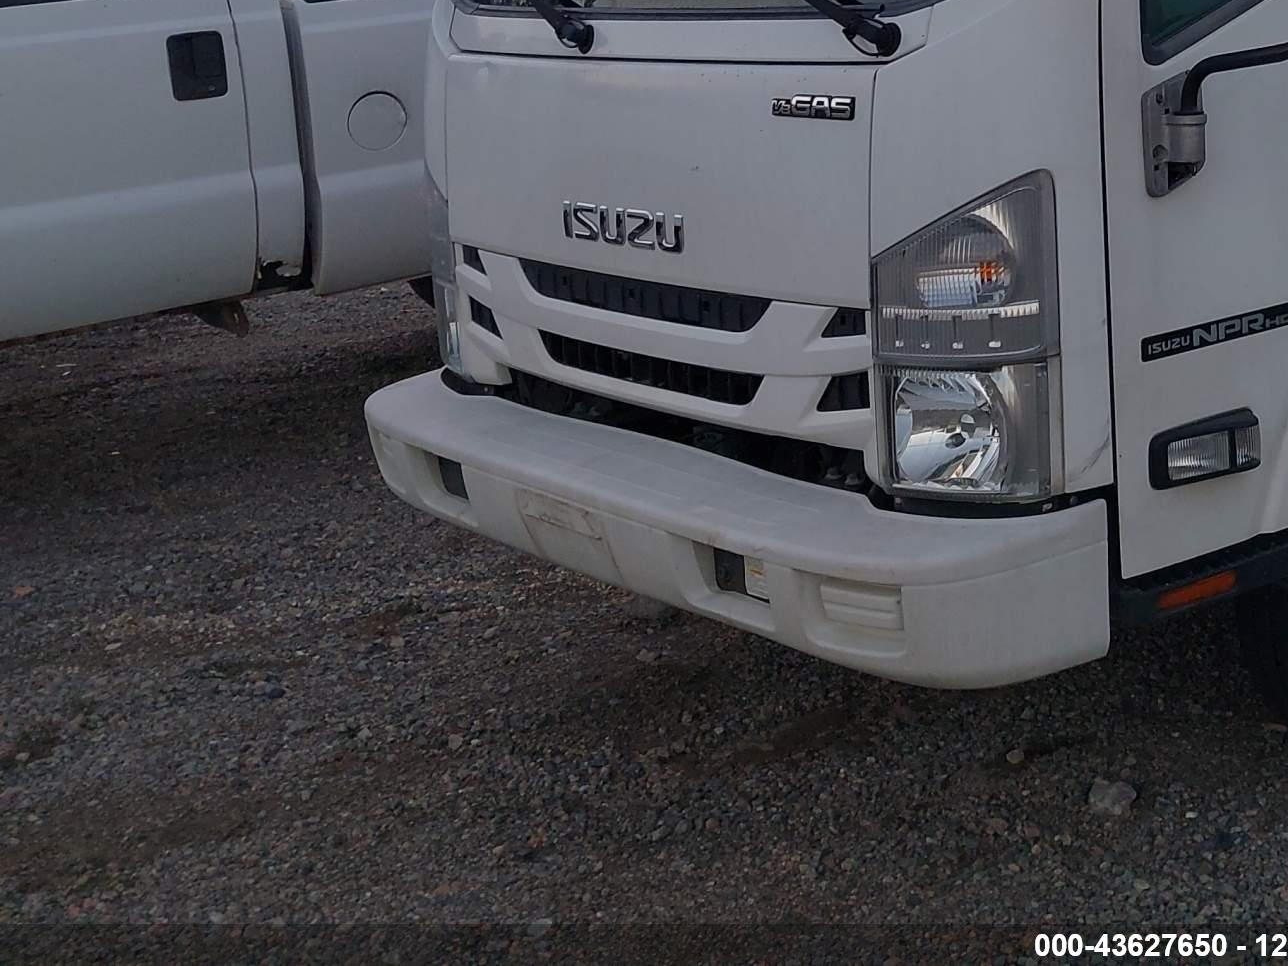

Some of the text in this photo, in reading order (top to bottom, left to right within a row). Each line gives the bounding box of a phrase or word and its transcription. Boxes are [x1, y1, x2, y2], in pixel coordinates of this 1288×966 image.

[562, 200, 684, 253] ISUZU
[1147, 335, 1191, 355] ISUZU
[1193, 313, 1266, 346] NPR
